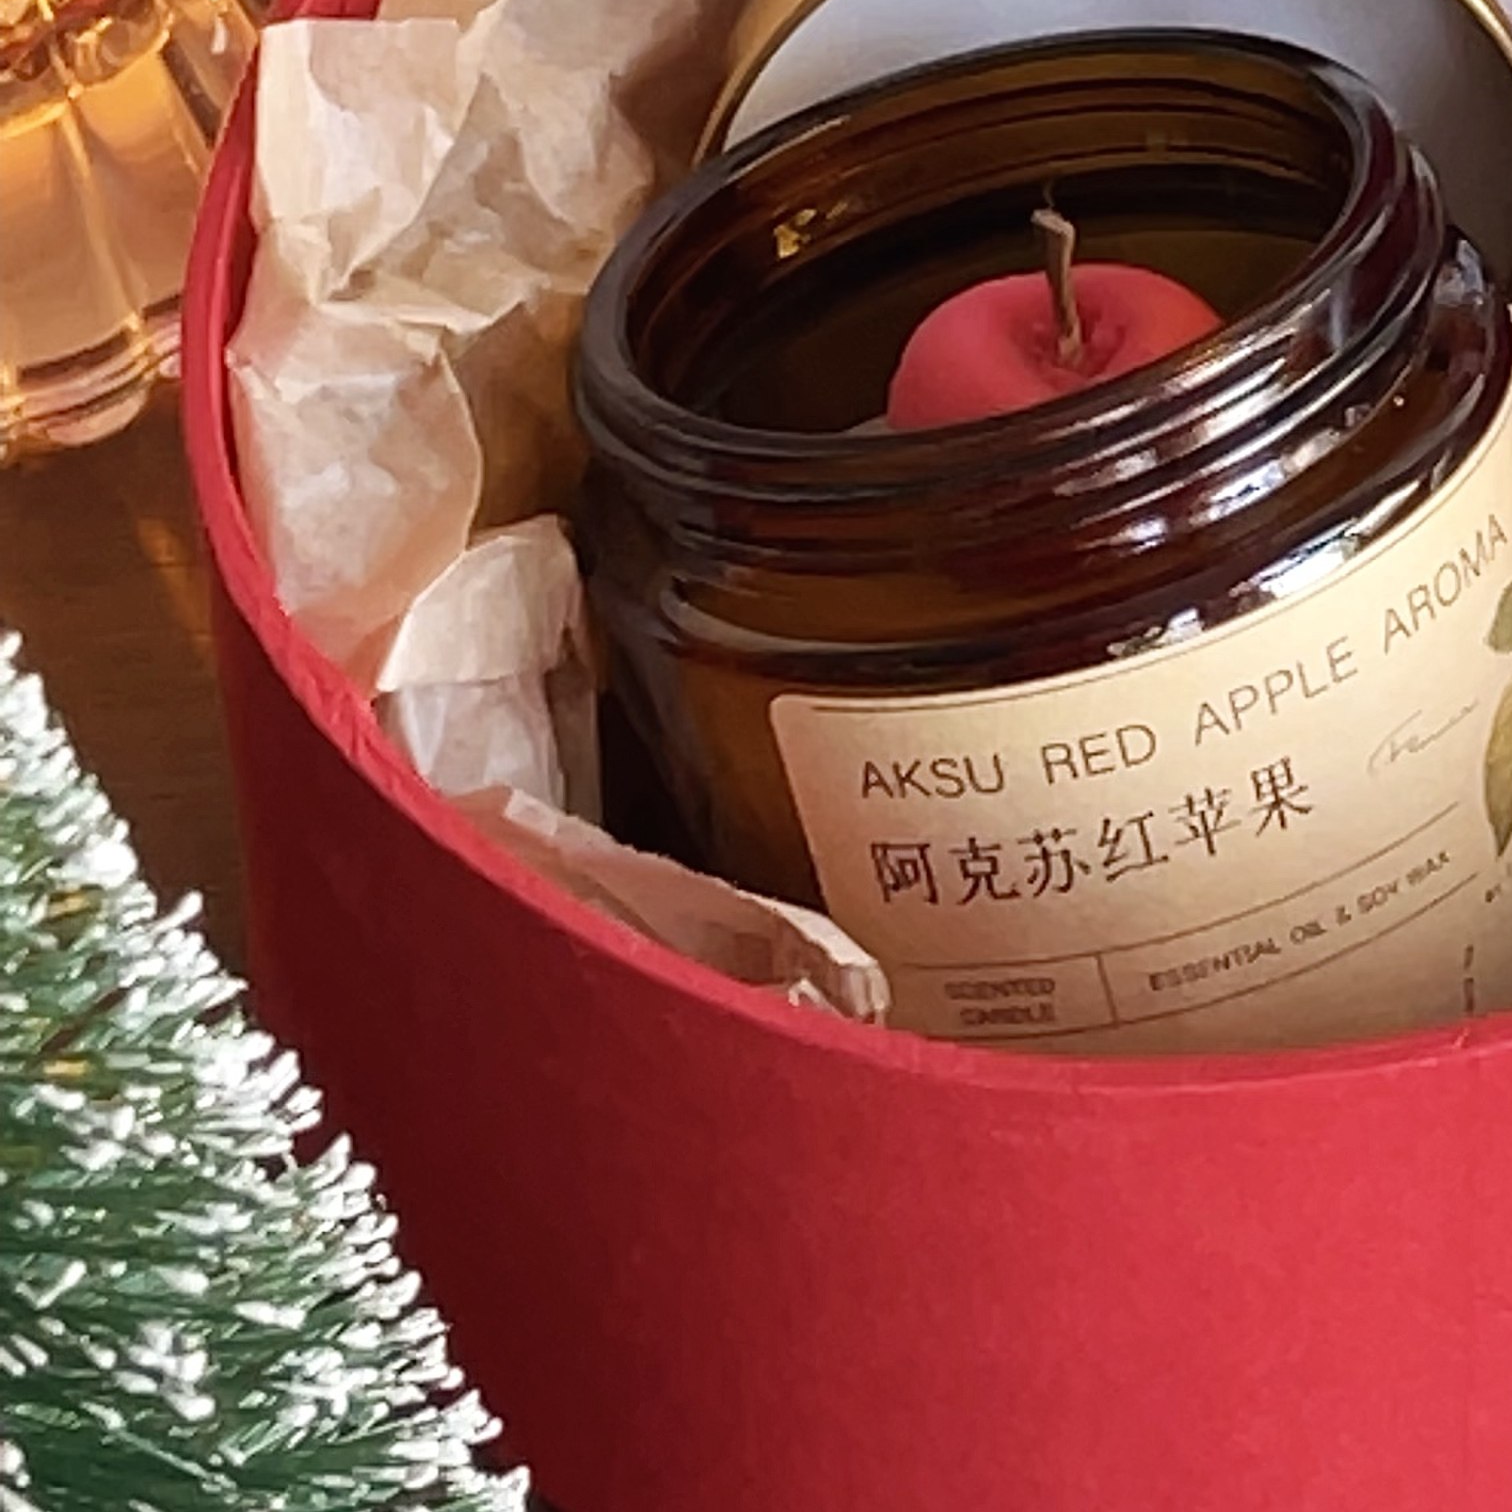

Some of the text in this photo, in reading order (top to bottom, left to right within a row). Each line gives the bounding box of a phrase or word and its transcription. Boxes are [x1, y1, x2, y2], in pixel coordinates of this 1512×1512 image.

[861, 753, 1005, 800] AKSU
[1041, 723, 1158, 785] RED
[1194, 635, 1358, 746] APPLE
[1383, 514, 1511, 654] AROMA
[870, 756, 1316, 908] 阿克苏红苹果
[1149, 938, 1282, 991] ESSENTIAL
